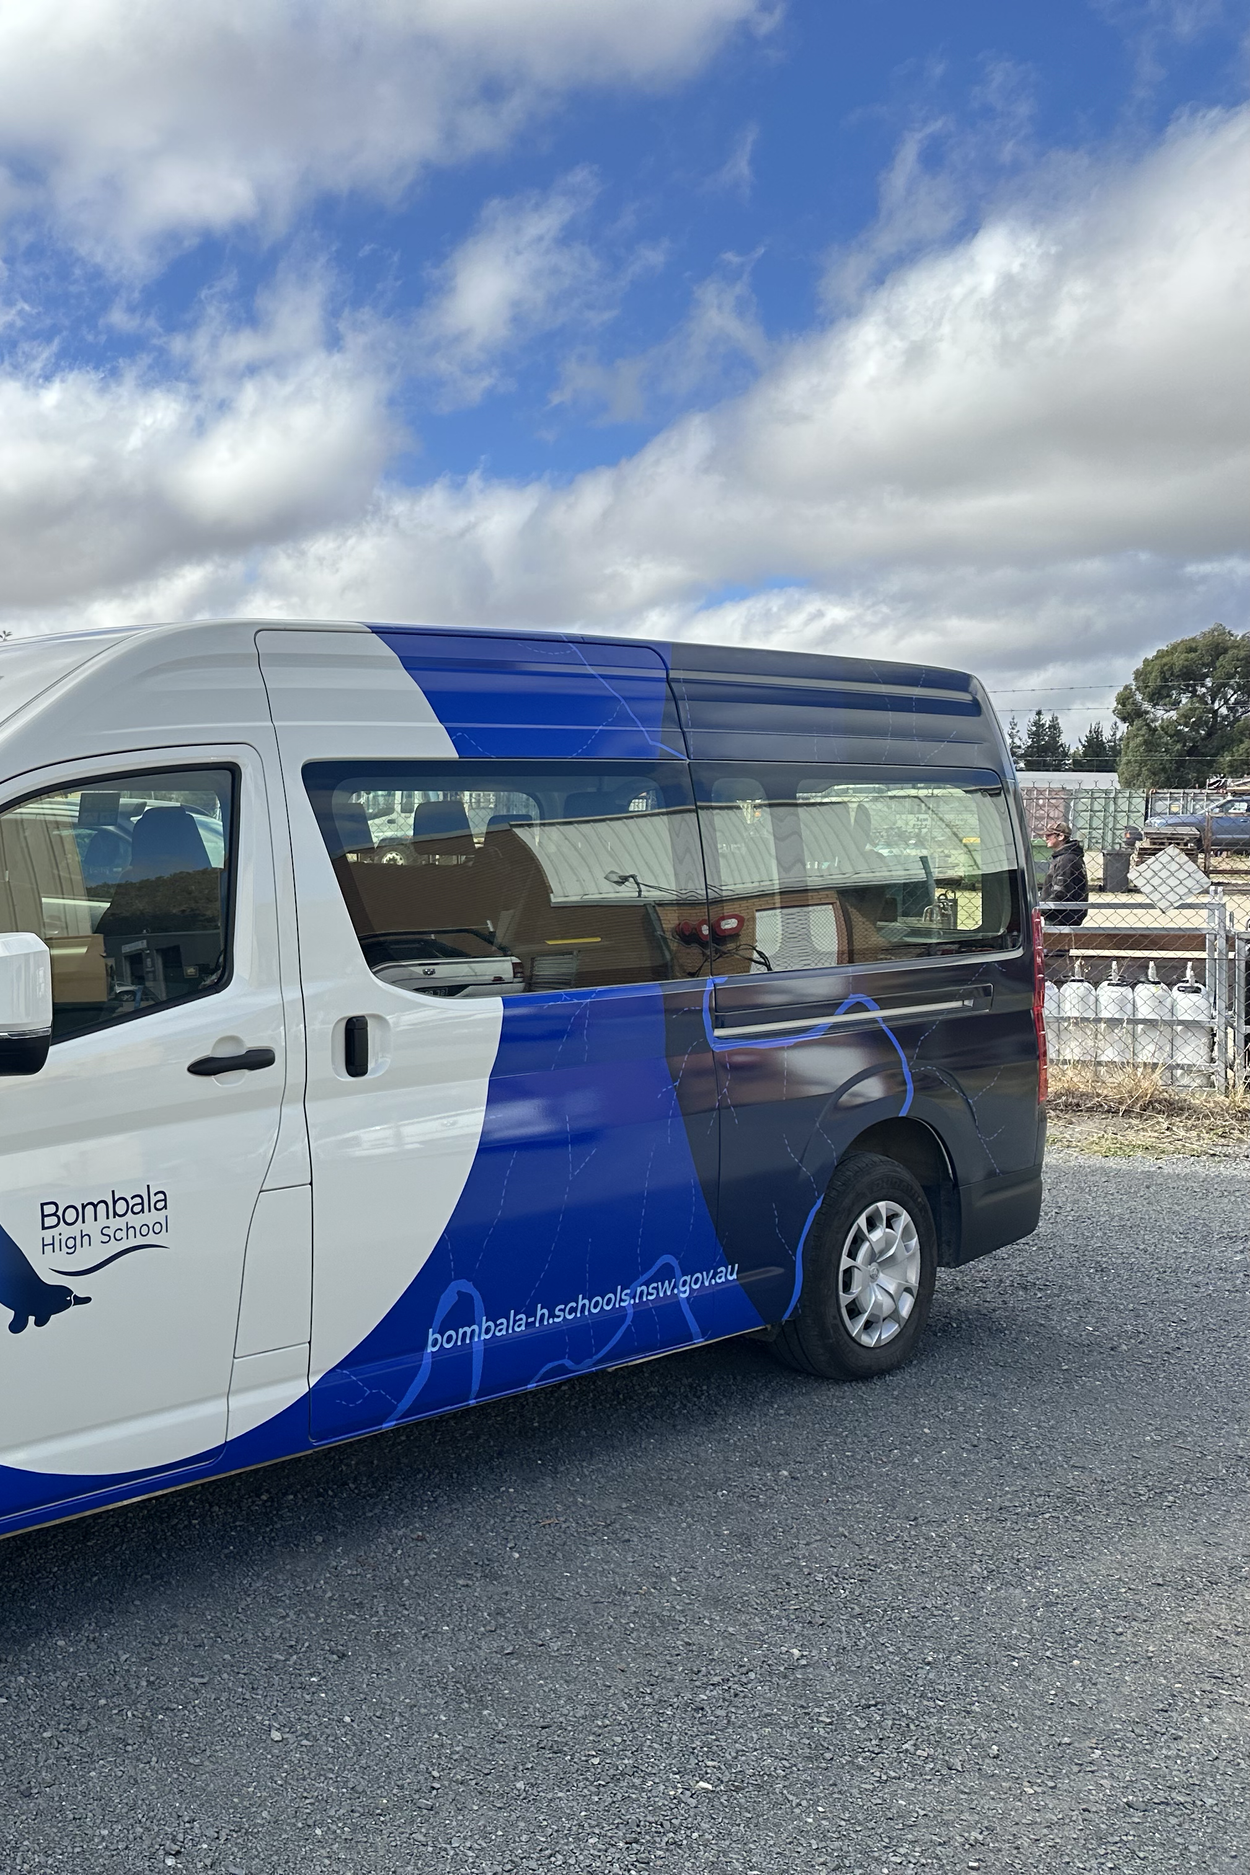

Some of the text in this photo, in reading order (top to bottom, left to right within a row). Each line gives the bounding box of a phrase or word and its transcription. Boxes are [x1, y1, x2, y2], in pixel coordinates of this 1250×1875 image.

[40, 1184, 168, 1231] Bombala
[41, 1214, 169, 1255] High School
[426, 1262, 739, 1353] bombala-h.schools.nsw.gov.au
